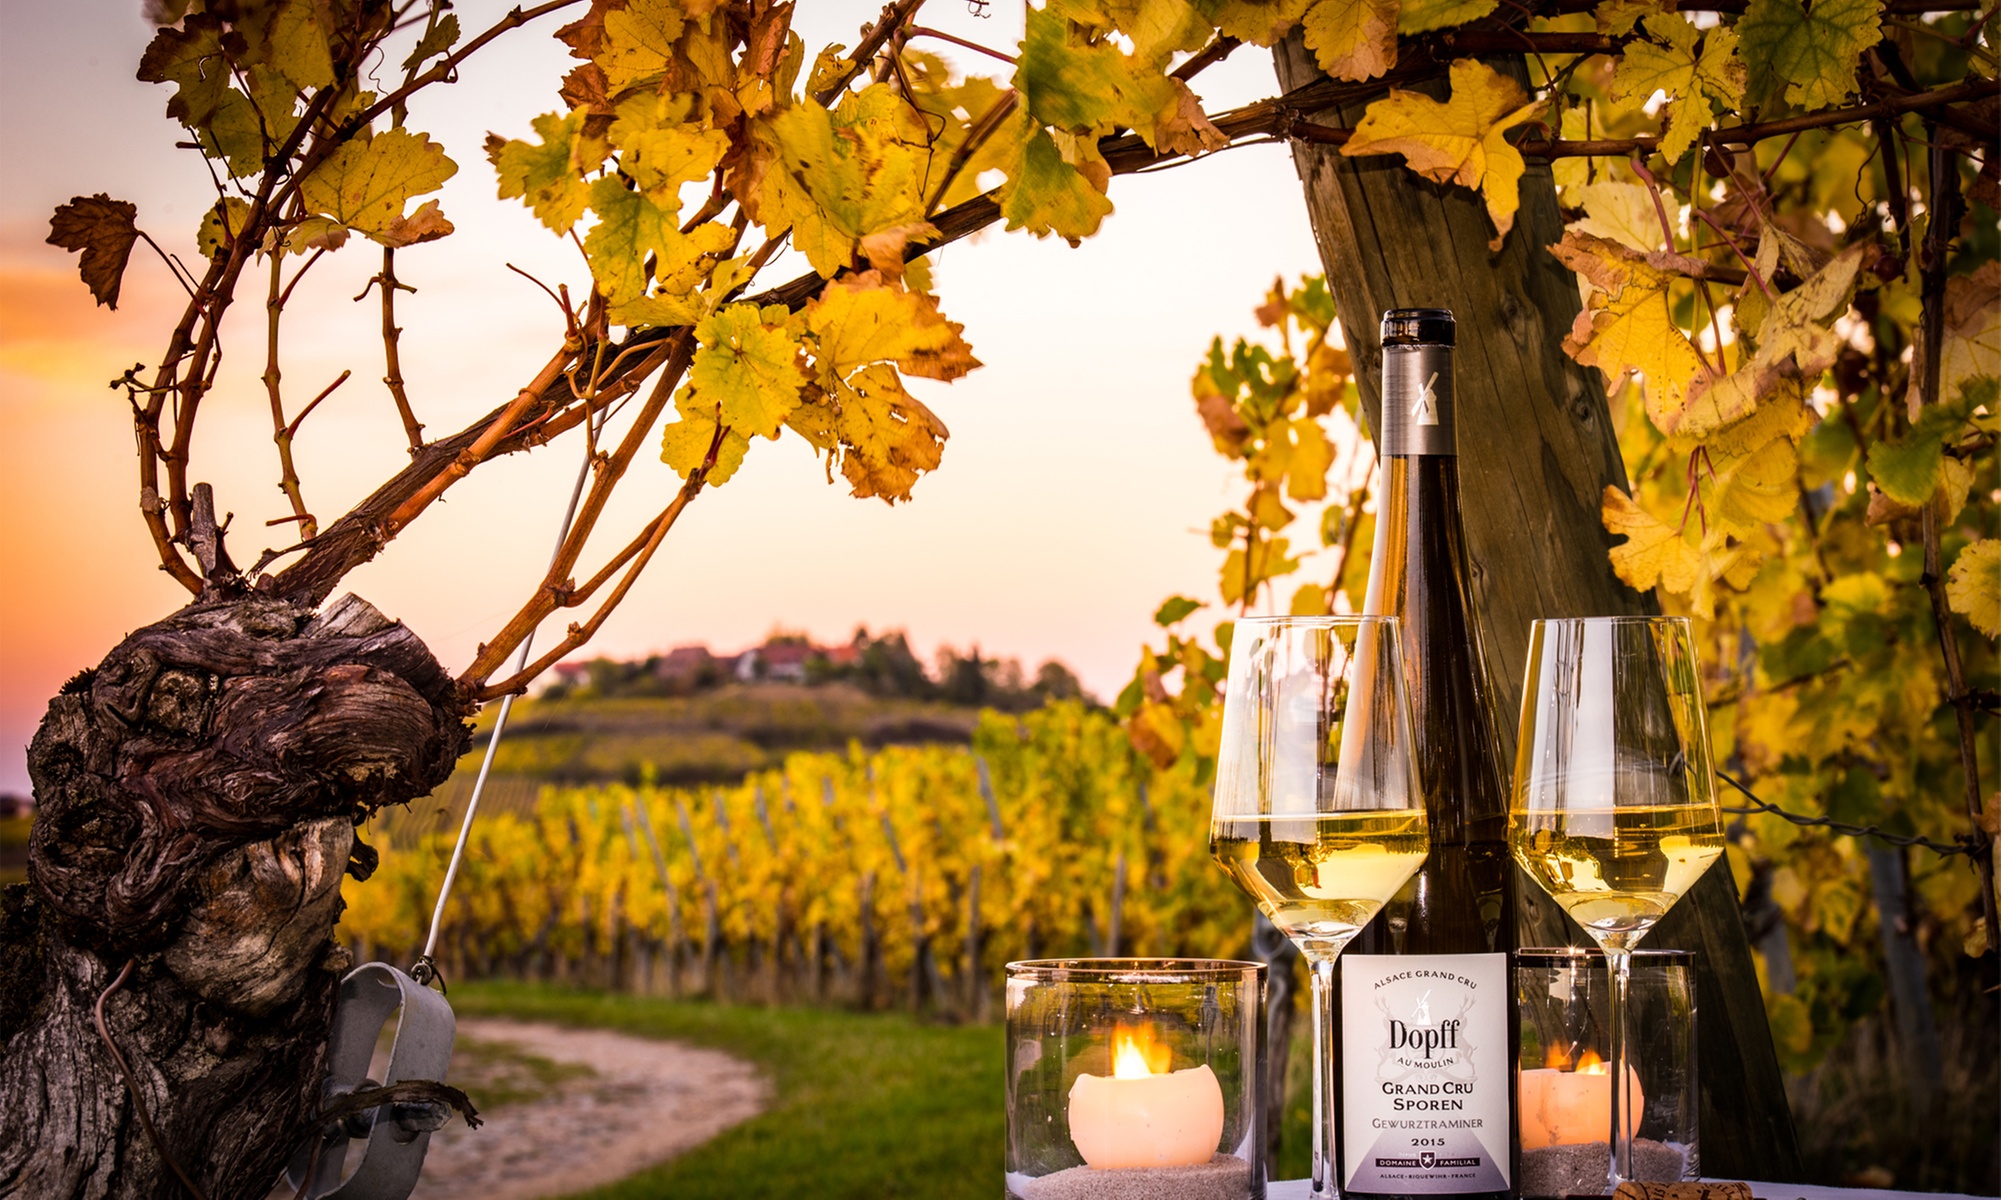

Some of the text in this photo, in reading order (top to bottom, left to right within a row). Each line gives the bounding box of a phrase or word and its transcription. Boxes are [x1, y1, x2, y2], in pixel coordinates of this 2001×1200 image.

[1374, 970, 1477, 990] ALSACE GRAND CRU
[1389, 1019, 1460, 1059] Dopff
[1397, 1057, 1454, 1069] AU MOULIN
[1382, 1082, 1473, 1094] GRAND CRU
[1393, 1098, 1463, 1111] SPOREN
[1372, 1118, 1483, 1129] GEWURZTRAMINER
[1411, 1138, 1445, 1146] 2015
